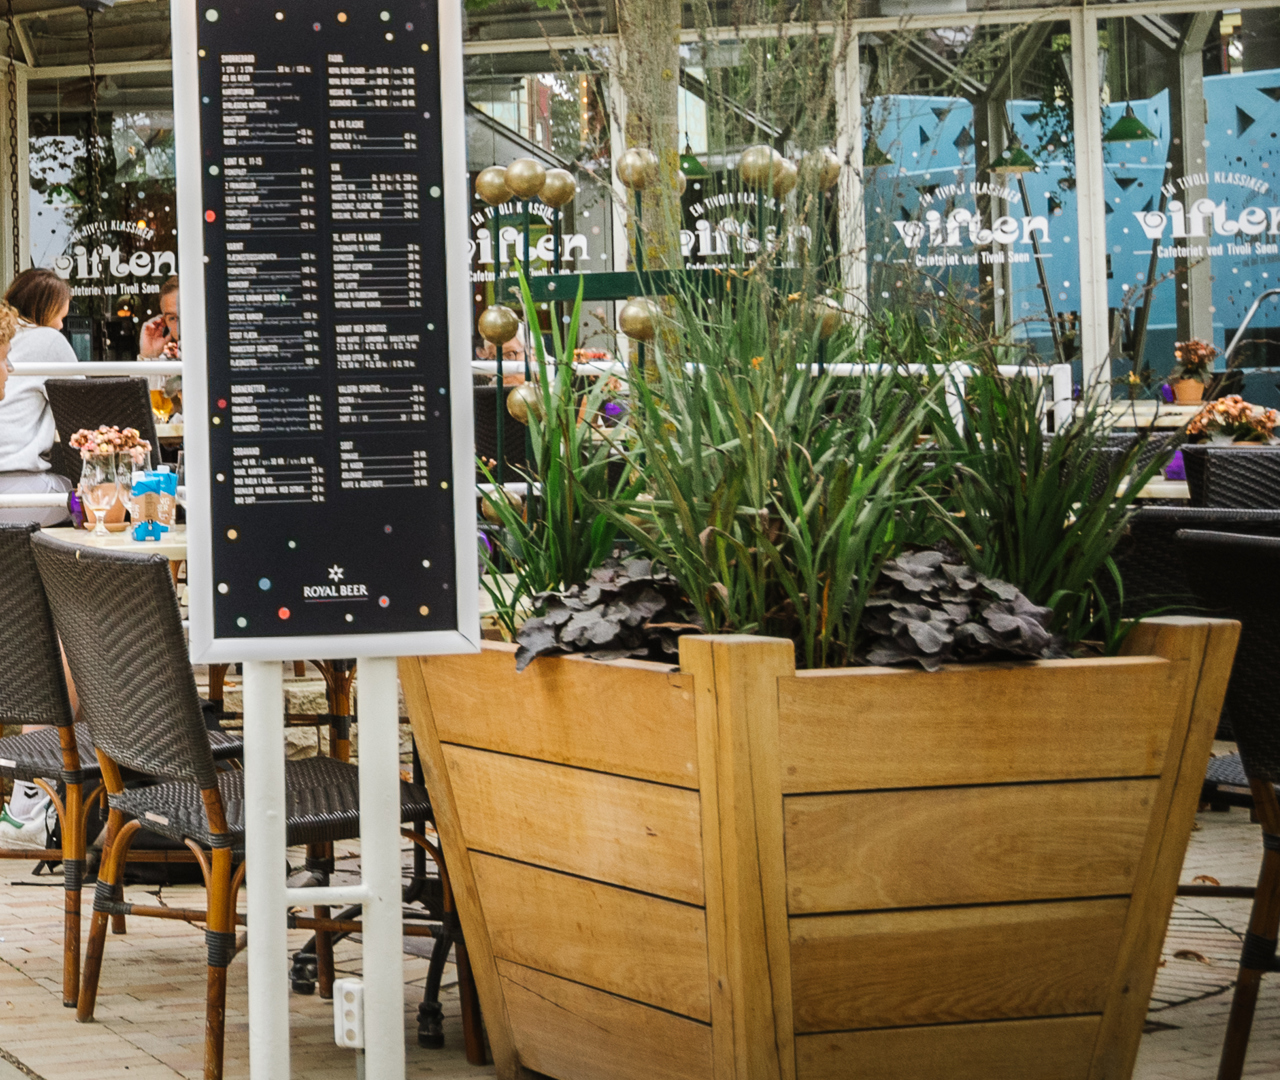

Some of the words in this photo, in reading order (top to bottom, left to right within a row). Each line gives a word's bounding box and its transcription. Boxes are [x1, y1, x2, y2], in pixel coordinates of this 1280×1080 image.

[1160, 184, 1176, 198] EN
[1176, 172, 1209, 190] TIVOLI
[1214, 171, 1270, 194] KLASSIKER
[969, 182, 1021, 205] KLASSIKER
[689, 203, 704, 217] EN
[471, 212, 485, 226] EN
[892, 208, 1052, 249] viften
[1157, 244, 1203, 258] Cafeteriet
[1207, 244, 1223, 256] ved
[1226, 243, 1251, 255] Tivoli
[1255, 242, 1278, 255] Søen
[980, 251, 1005, 264] Tivoli
[1007, 251, 1030, 263] Søen
[120, 283, 139, 294] Tivoli
[304, 586, 339, 598] ROYAL
[340, 584, 368, 596] BEER
